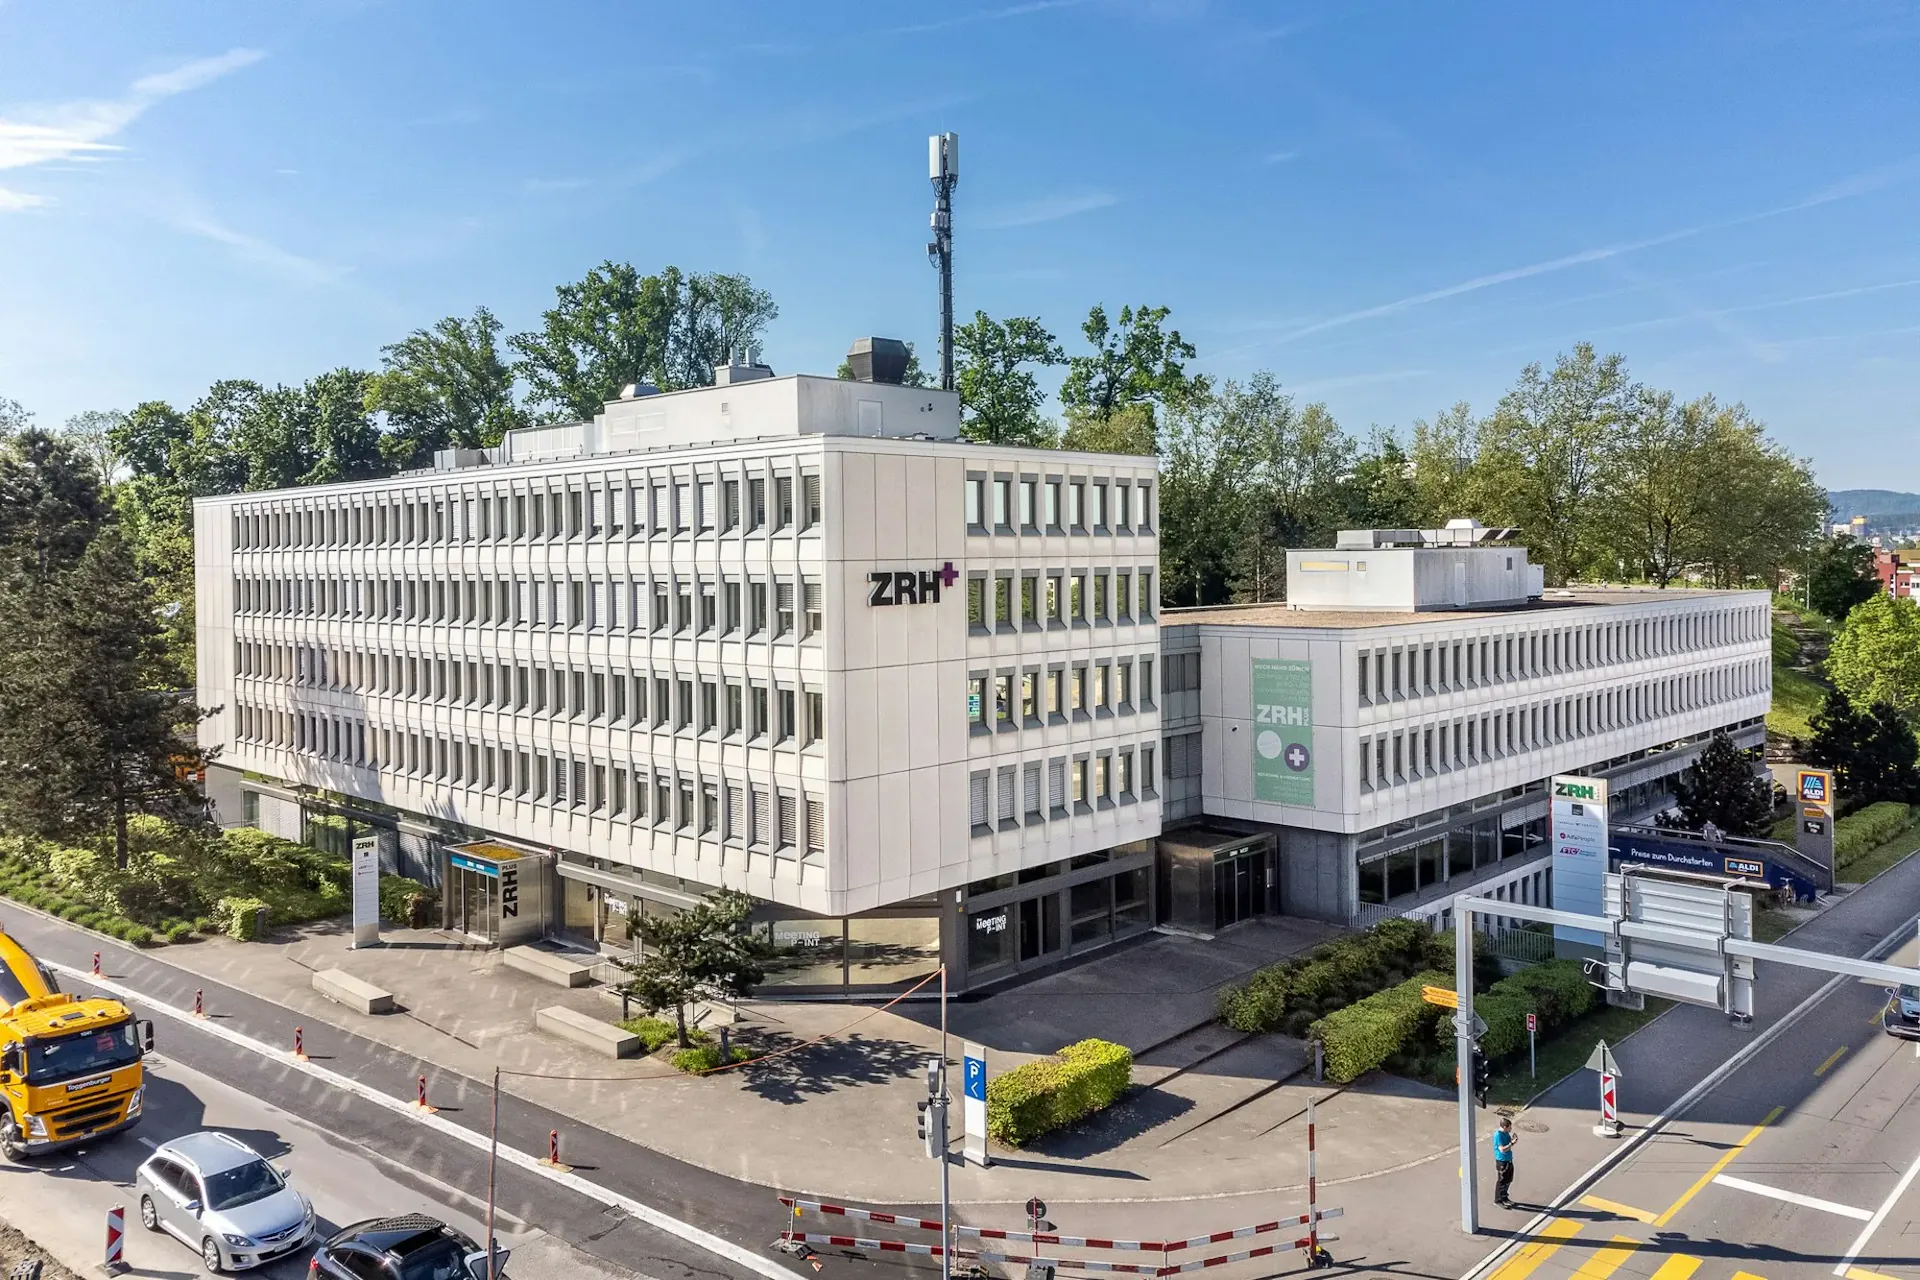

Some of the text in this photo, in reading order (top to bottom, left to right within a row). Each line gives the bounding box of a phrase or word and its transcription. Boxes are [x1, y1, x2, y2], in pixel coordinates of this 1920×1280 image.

[1256, 704, 1303, 726] ZRH
[1555, 783, 1594, 800] ZRH
[1803, 788, 1824, 797] ALDI
[356, 841, 375, 850] ZRH
[1567, 834, 1596, 843] AlfaPeople
[1631, 848, 1714, 868] Preise zum Durchstarten
[1738, 863, 1759, 872] ALDI
[502, 870, 518, 919] ZRH
[67, 1076, 111, 1091] Toggenburger
